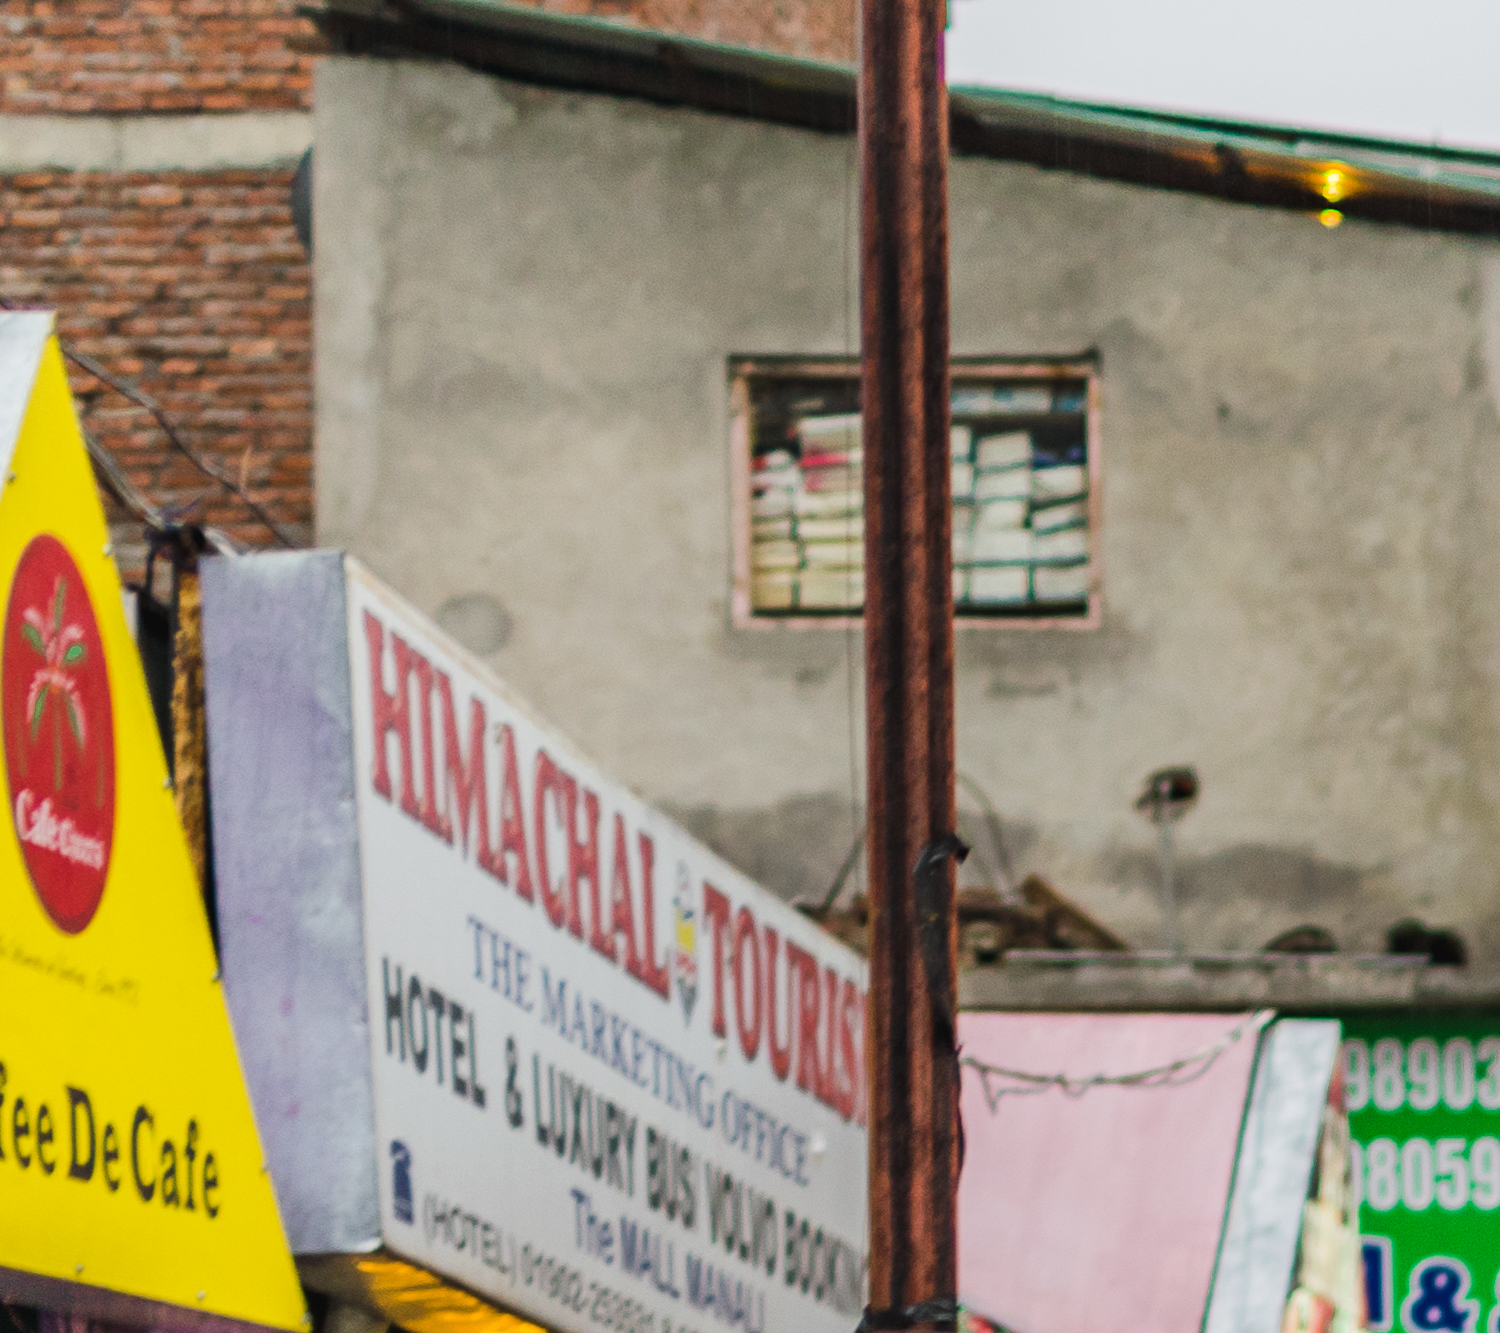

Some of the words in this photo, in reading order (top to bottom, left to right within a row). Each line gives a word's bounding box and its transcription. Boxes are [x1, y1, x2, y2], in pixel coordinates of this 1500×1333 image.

[364, 606, 669, 1001] HIMACHAL
[383, 956, 486, 1109] HOTEL
[506, 1035, 523, 1129] &
[534, 1052, 636, 1198] LUXURY
[467, 914, 533, 1013] THE
[541, 966, 715, 1130] MARKETING
[724, 1090, 809, 1188] OFFICE
[66, 1084, 120, 1193] De
[131, 1104, 219, 1220] Cafe
[423, 1192, 517, 1287] (HOTEL)
[571, 1187, 614, 1265] The
[620, 1216, 681, 1299] MALL
